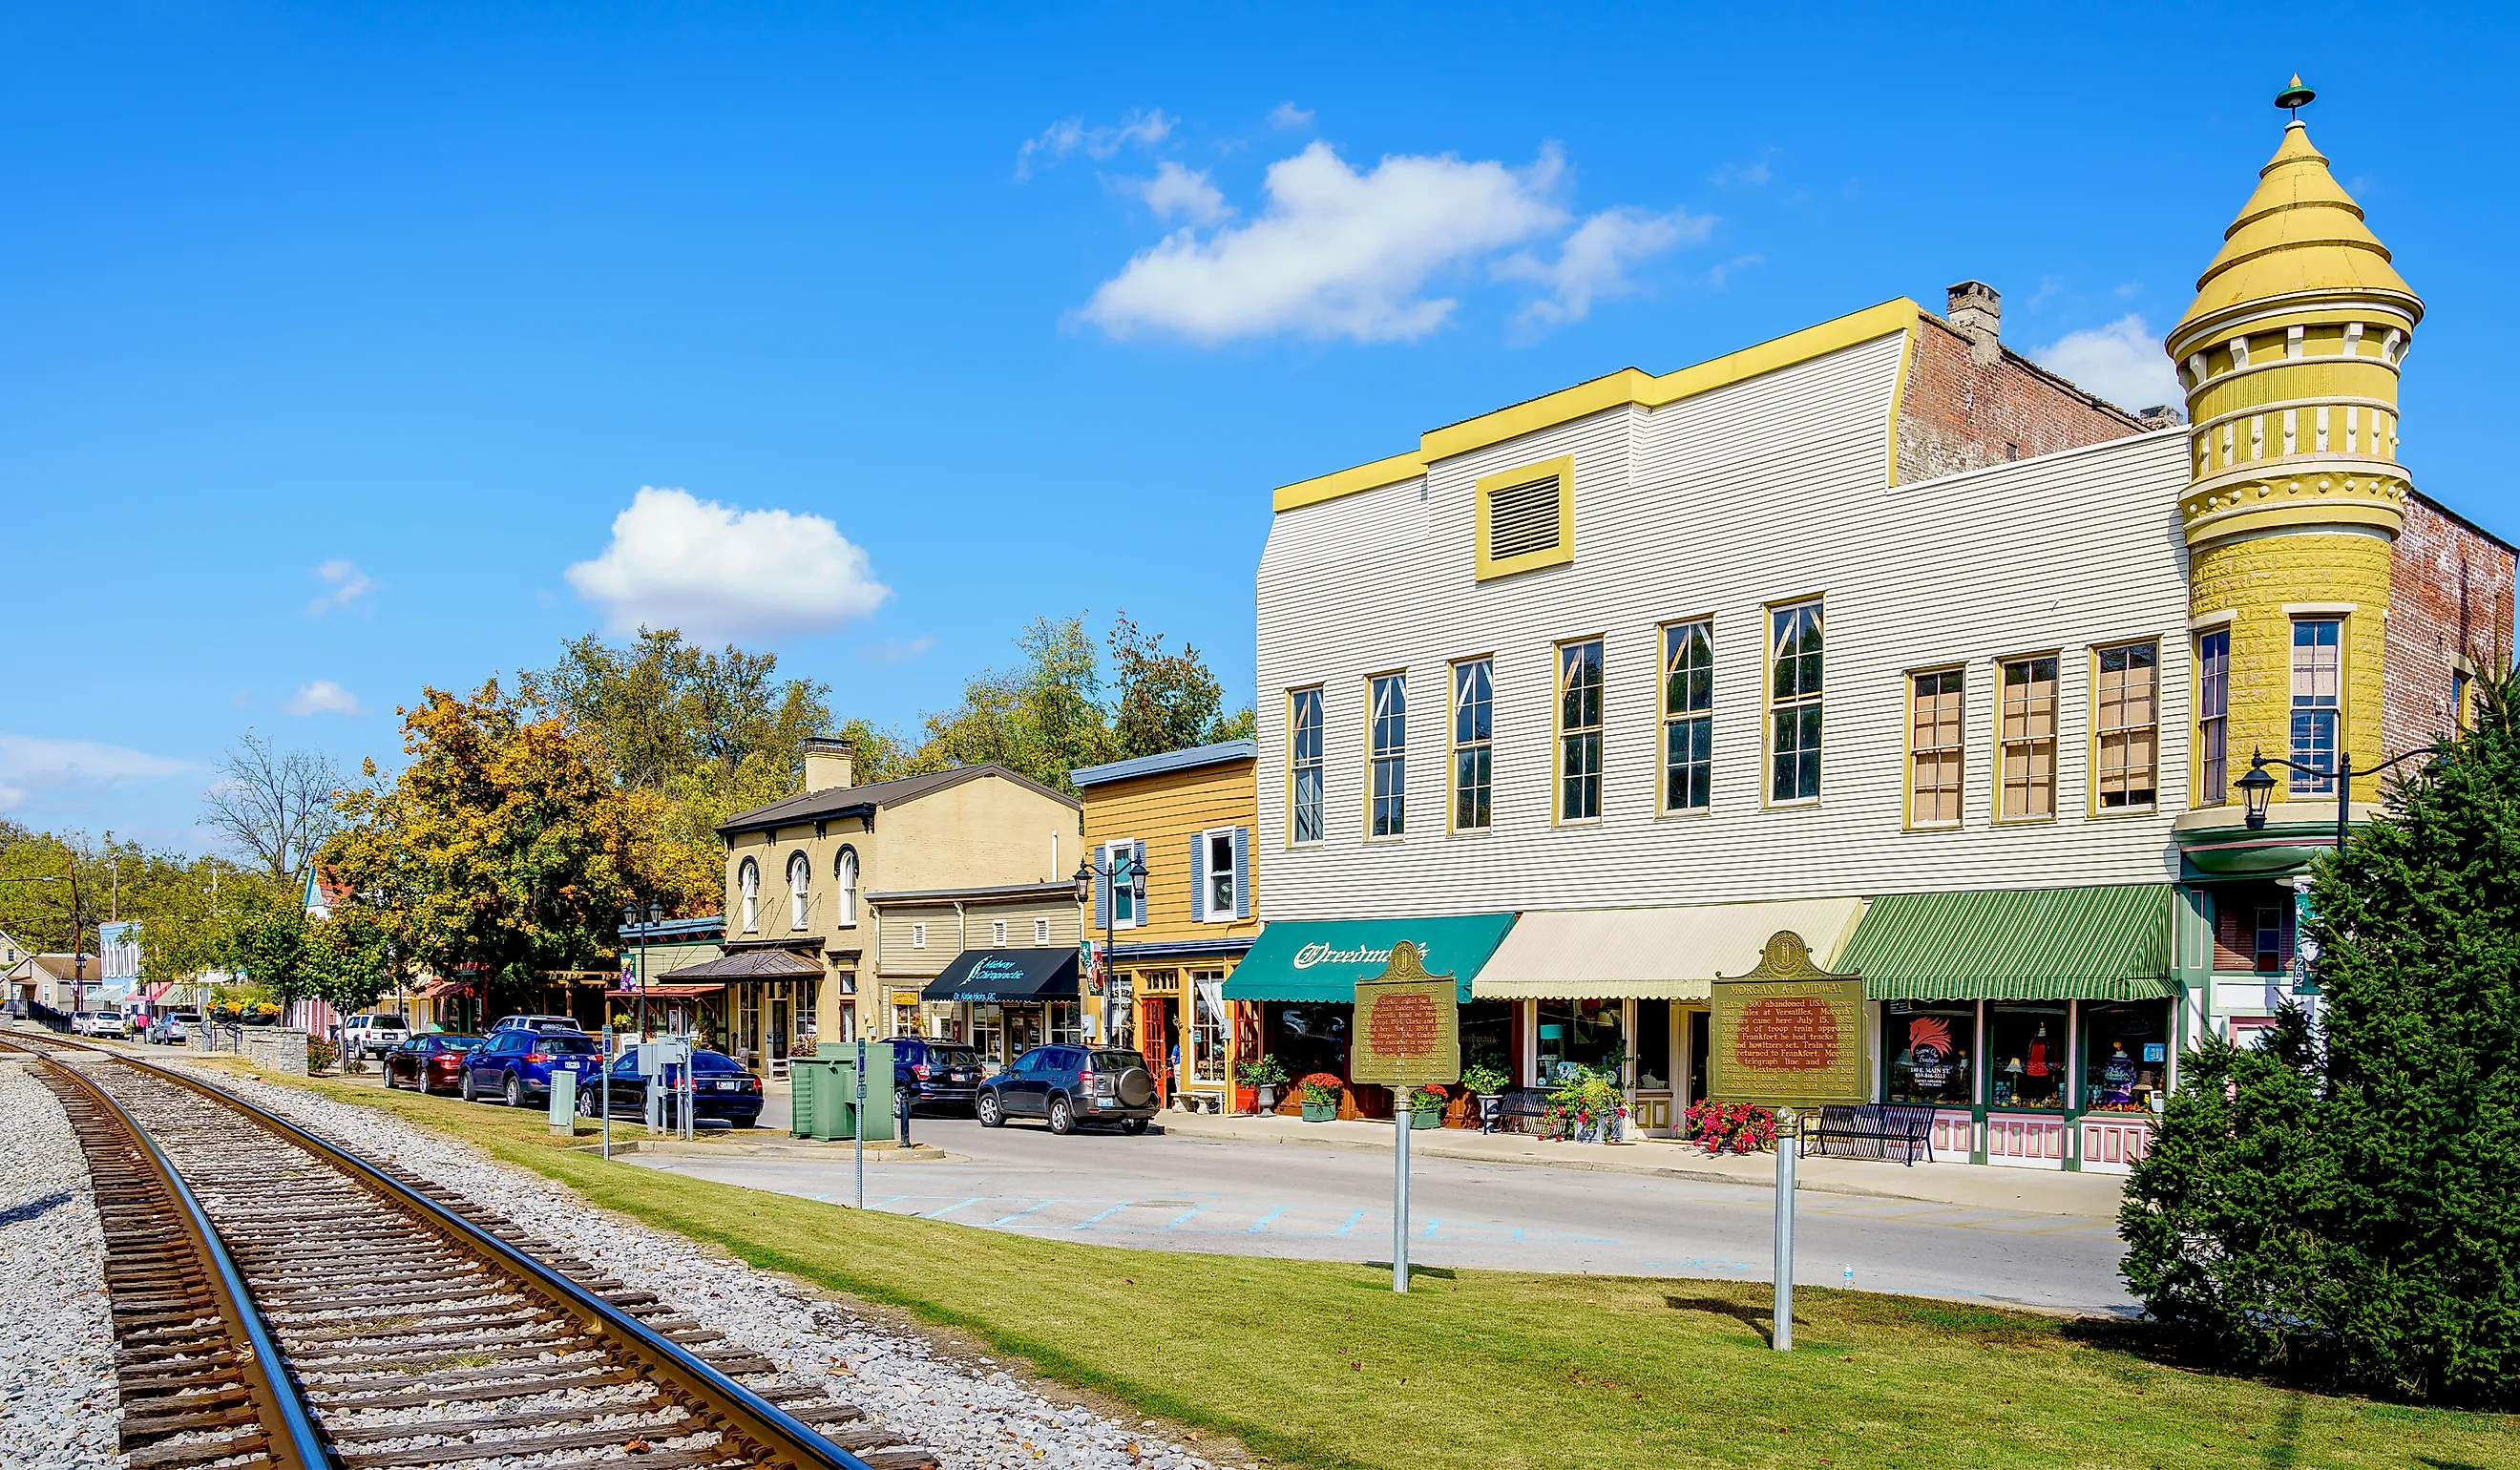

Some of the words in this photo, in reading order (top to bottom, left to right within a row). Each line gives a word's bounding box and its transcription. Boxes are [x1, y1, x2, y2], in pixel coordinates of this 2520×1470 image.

[981, 960, 1017, 970] Midway
[976, 970, 1025, 981] Chiropractic
[1420, 984, 1438, 993] HERE
[1730, 985, 1775, 996] MORGAN
[1781, 985, 1795, 995] AT
[1800, 983, 1843, 994] MIDWAY
[1721, 1001, 1745, 1010] Taking
[1765, 999, 1805, 1008] abandoned
[1820, 1008, 1855, 1017] Morgan's
[1796, 1016, 1815, 1025] July
[1817, 1025, 1855, 1034] approach
[1824, 1050, 1855, 1059] Morgan
[1744, 1058, 1778, 1066] telegraph
[1754, 1066, 1790, 1075] Lexington
[1822, 1074, 1834, 1082] his
[1754, 1082, 1797, 1091] Georgetown
[1822, 1083, 1855, 1093] evening.
